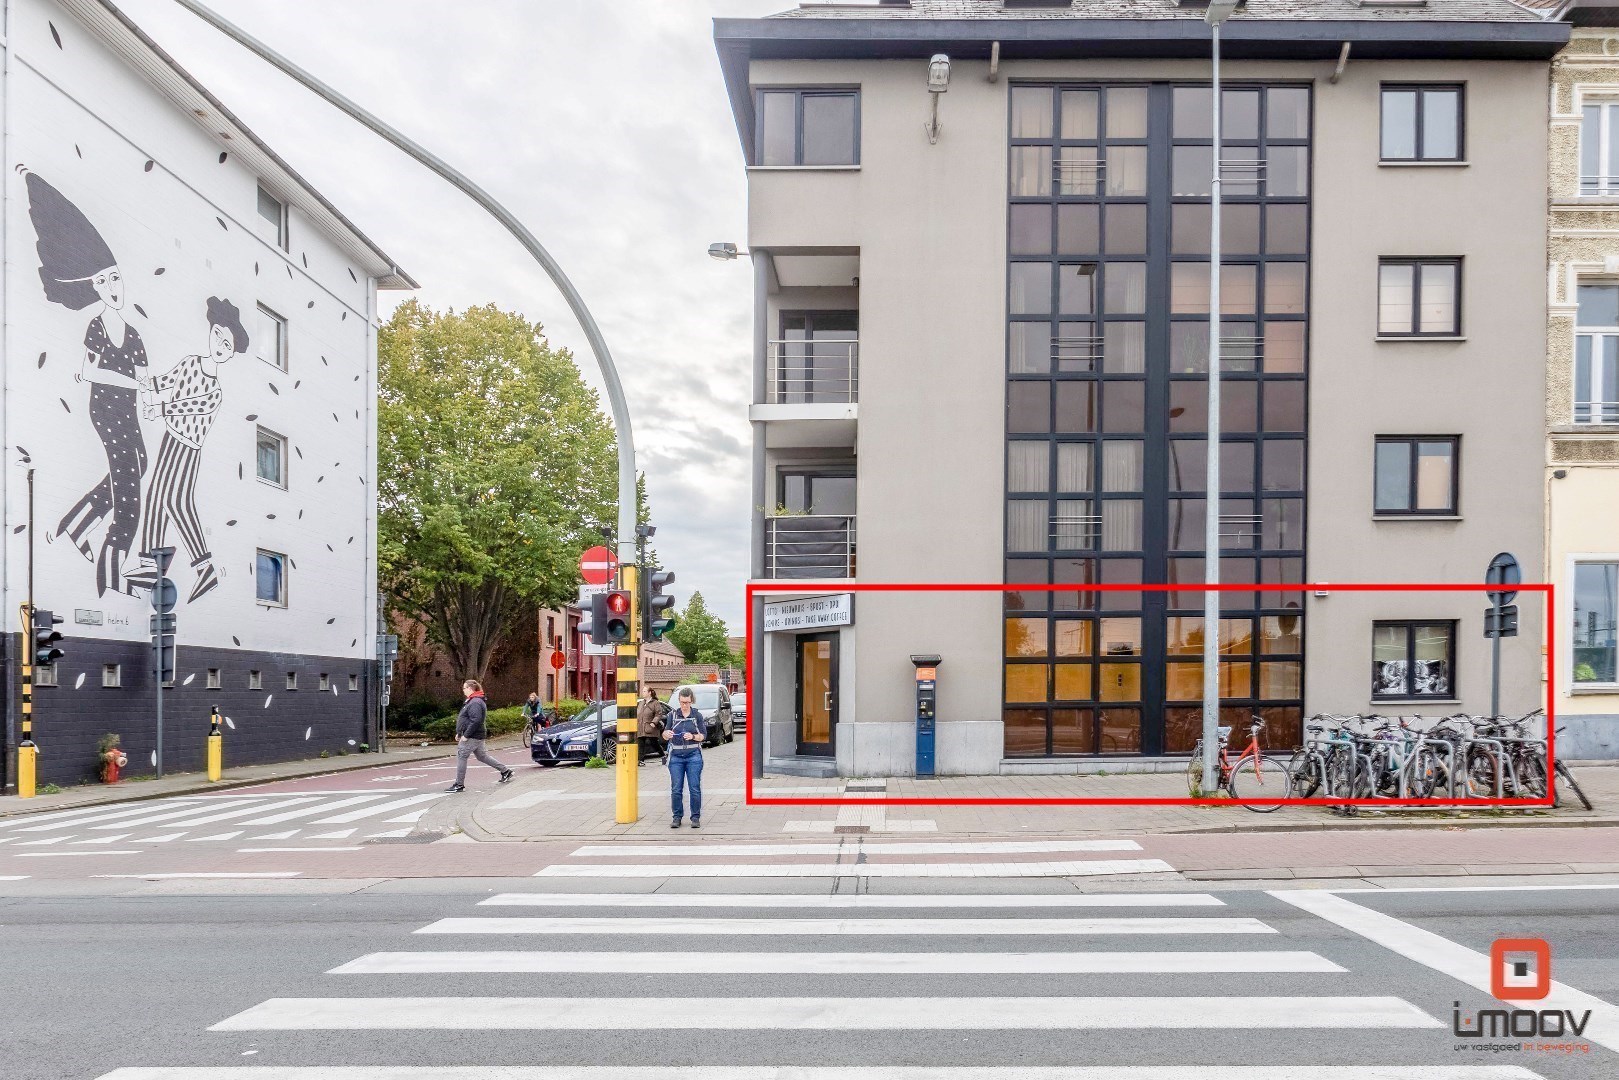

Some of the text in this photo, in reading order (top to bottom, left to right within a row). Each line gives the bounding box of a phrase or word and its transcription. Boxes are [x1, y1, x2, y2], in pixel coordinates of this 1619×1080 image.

[806, 615, 815, 624] TAKE
[818, 613, 829, 623] AWAY
[830, 611, 847, 622] COFFEE
